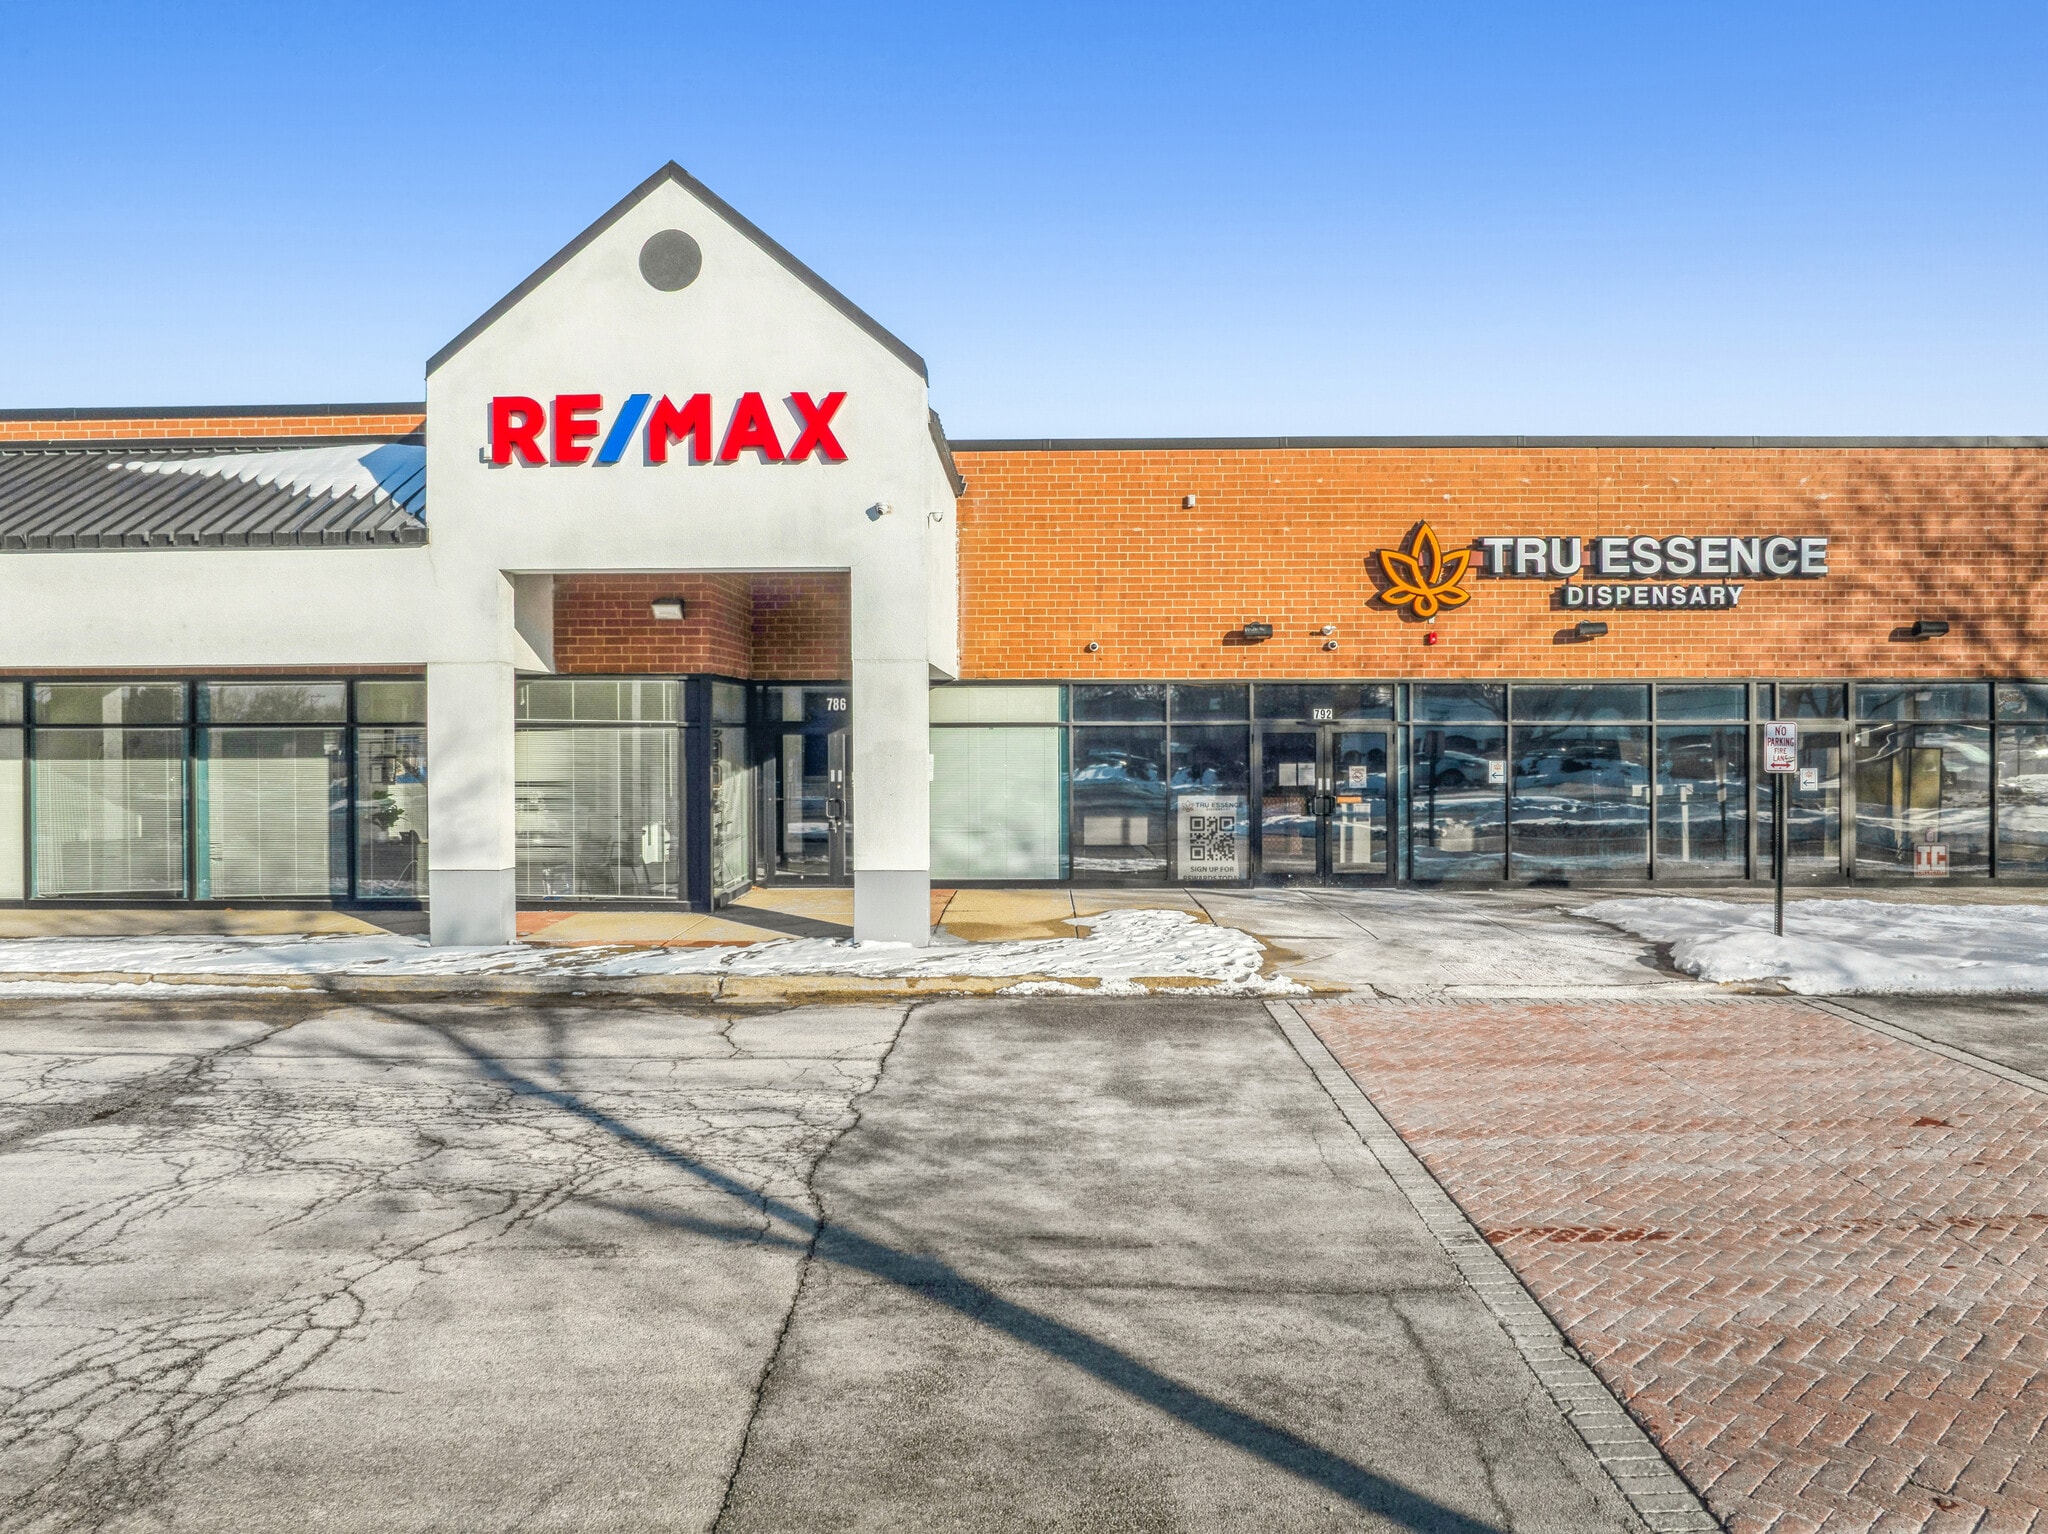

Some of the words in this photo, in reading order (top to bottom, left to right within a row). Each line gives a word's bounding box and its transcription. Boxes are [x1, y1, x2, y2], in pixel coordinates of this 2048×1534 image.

[492, 391, 849, 465] RE/MAX
[1481, 536, 1582, 576] TRU
[1600, 536, 1828, 576] ESSENCE
[1566, 585, 1744, 606] DISPENSARY
[826, 697, 847, 712] 786
[1314, 709, 1332, 719] 792
[1775, 727, 1787, 736] NO
[1768, 738, 1794, 746] PARKING
